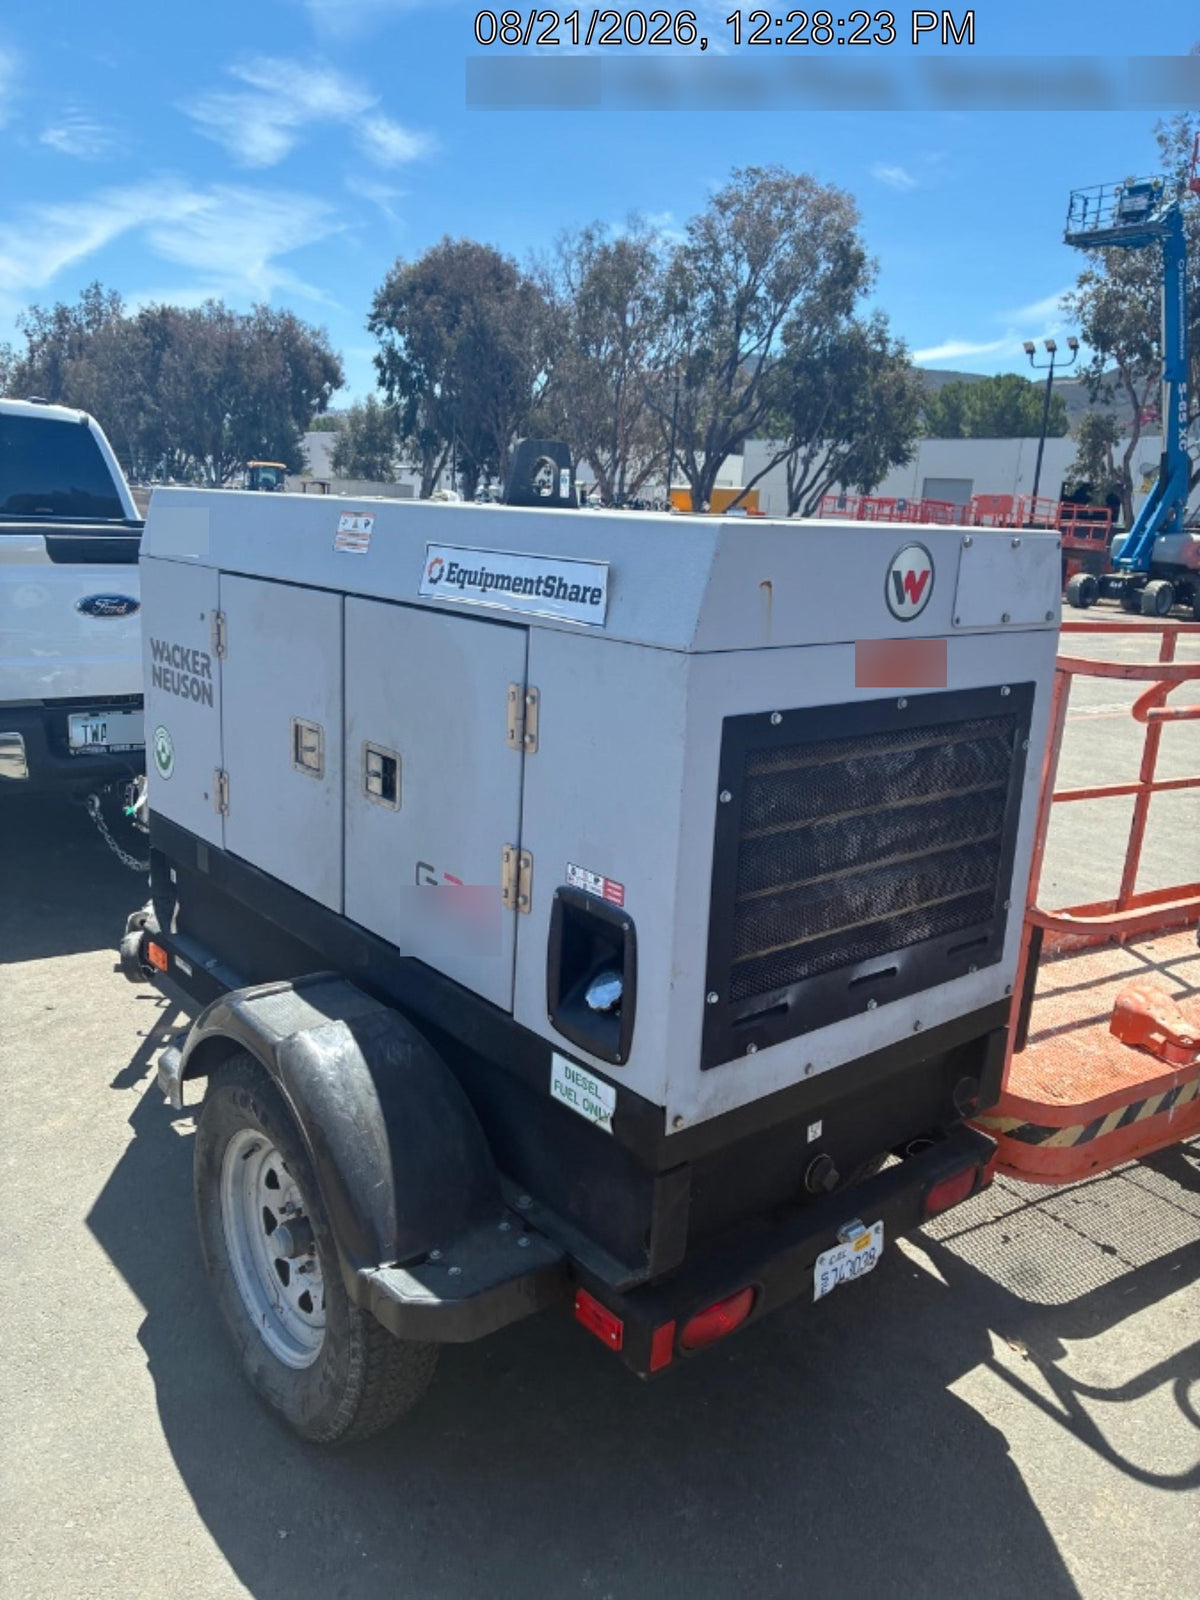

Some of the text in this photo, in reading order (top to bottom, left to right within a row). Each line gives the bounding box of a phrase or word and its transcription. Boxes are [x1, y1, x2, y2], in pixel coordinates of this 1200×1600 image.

[445, 562, 602, 605] EquipmentShare
[93, 598, 128, 614] Ford
[150, 637, 212, 679] WACKER
[152, 664, 214, 708] NEUSON
[554, 1080, 610, 1120] FUEL ONLY
[565, 1066, 601, 1100] DIESEL
